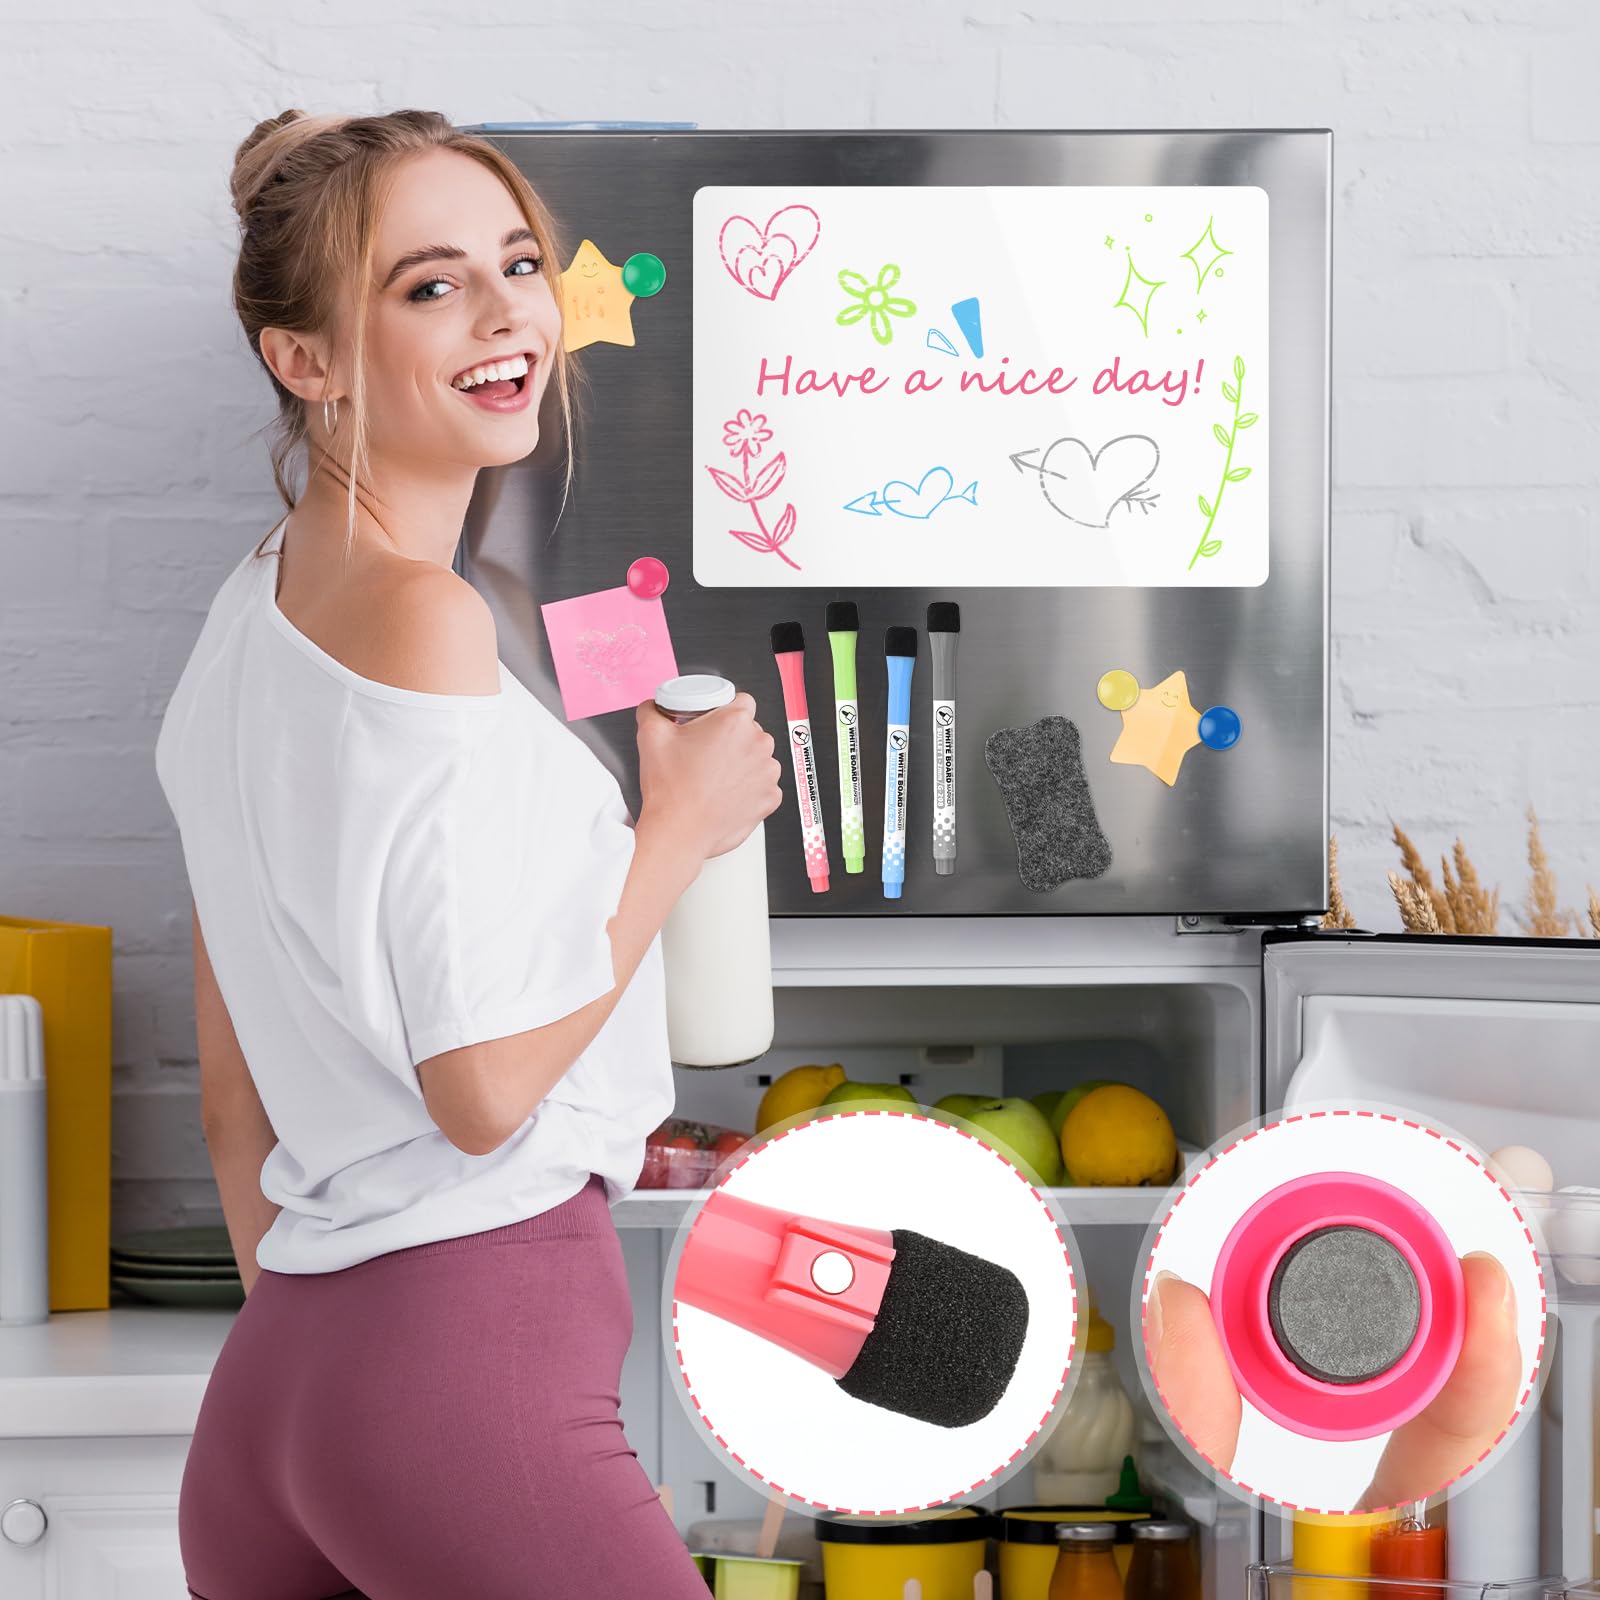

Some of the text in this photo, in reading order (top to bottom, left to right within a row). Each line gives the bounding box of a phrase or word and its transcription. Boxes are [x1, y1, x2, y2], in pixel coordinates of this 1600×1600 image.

[756, 355, 1205, 406] Have a nice day!
[850, 755, 858, 782] BOARD
[807, 774, 816, 801] BOARD
